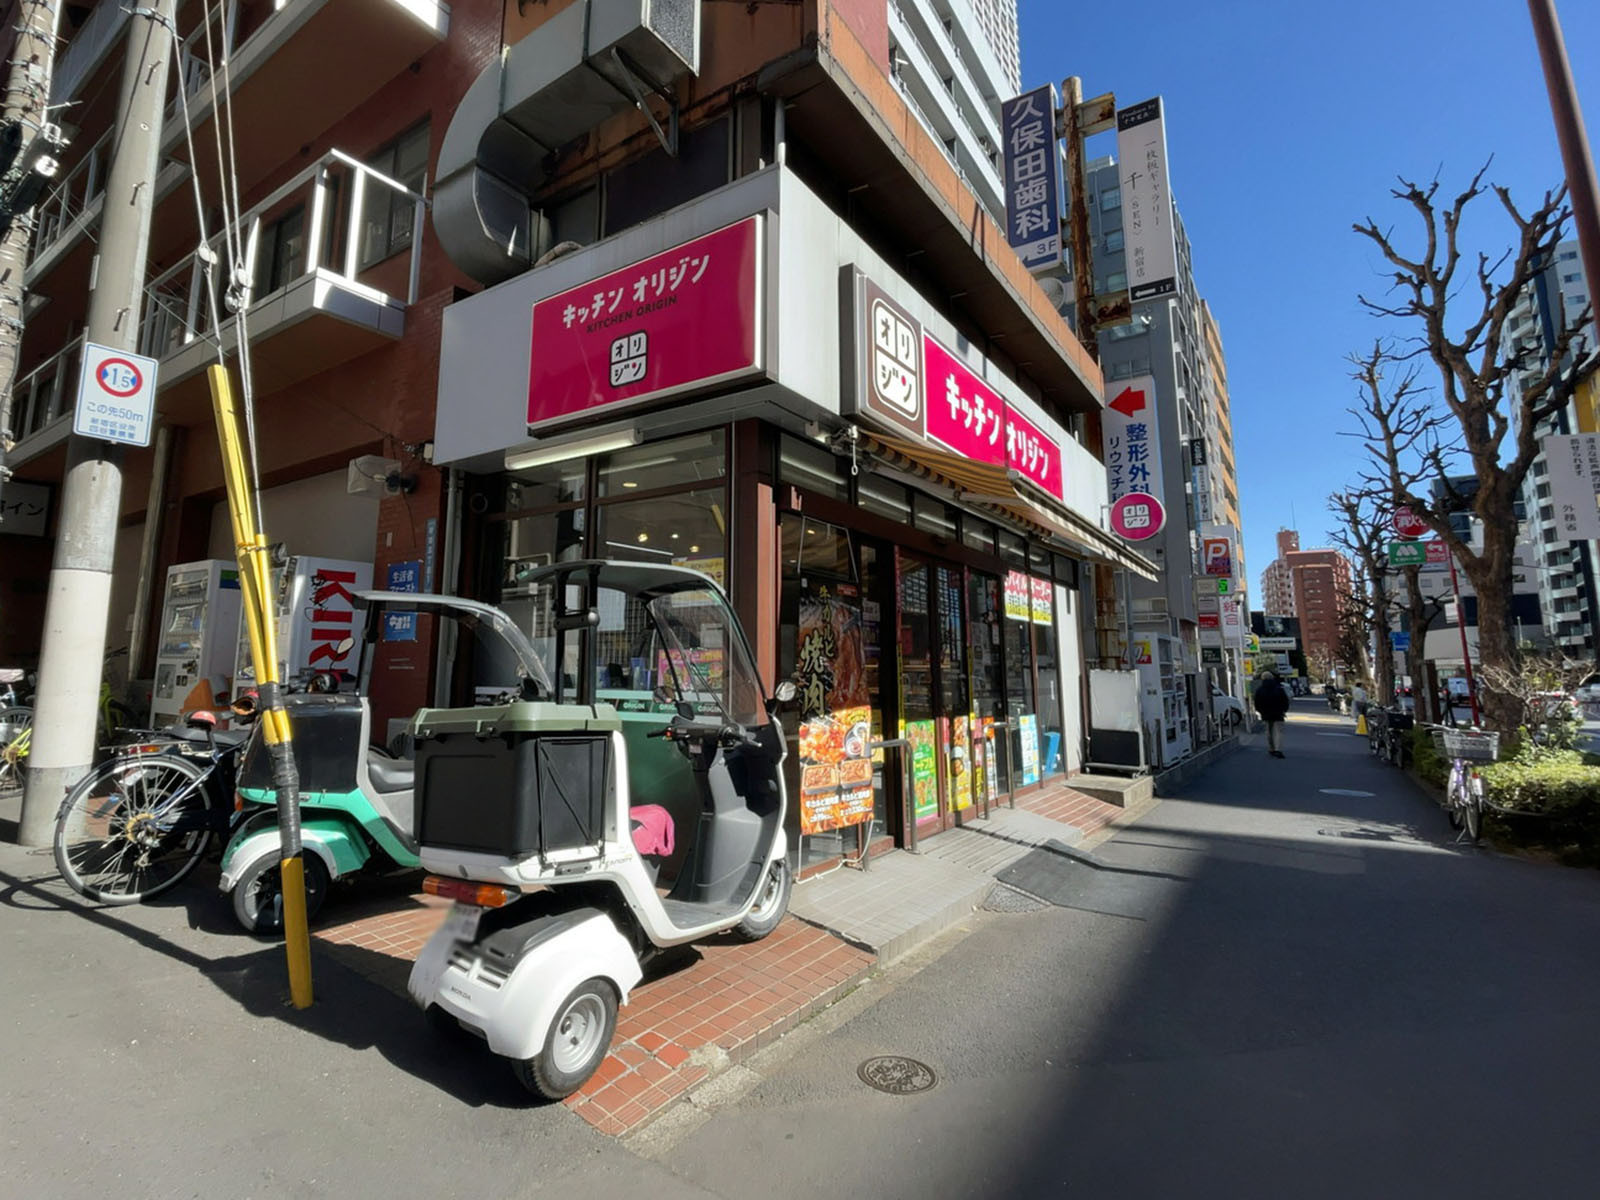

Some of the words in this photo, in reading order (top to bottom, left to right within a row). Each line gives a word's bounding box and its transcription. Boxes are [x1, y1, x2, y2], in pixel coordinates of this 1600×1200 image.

[1010, 95, 1051, 240] 久保田歯科
[1036, 240, 1057, 256] 3F
[563, 287, 624, 329] キッチン
[632, 254, 710, 303] オリジン
[586, 309, 633, 334] KITCHEN
[636, 294, 678, 317] ORIGIN
[945, 373, 1000, 446] キッチン
[1006, 421, 1049, 480] オリジン
[1396, 513, 1427, 528] 消火
[1207, 543, 1227, 565] P
[820, 585, 835, 657] 牛カルビ
